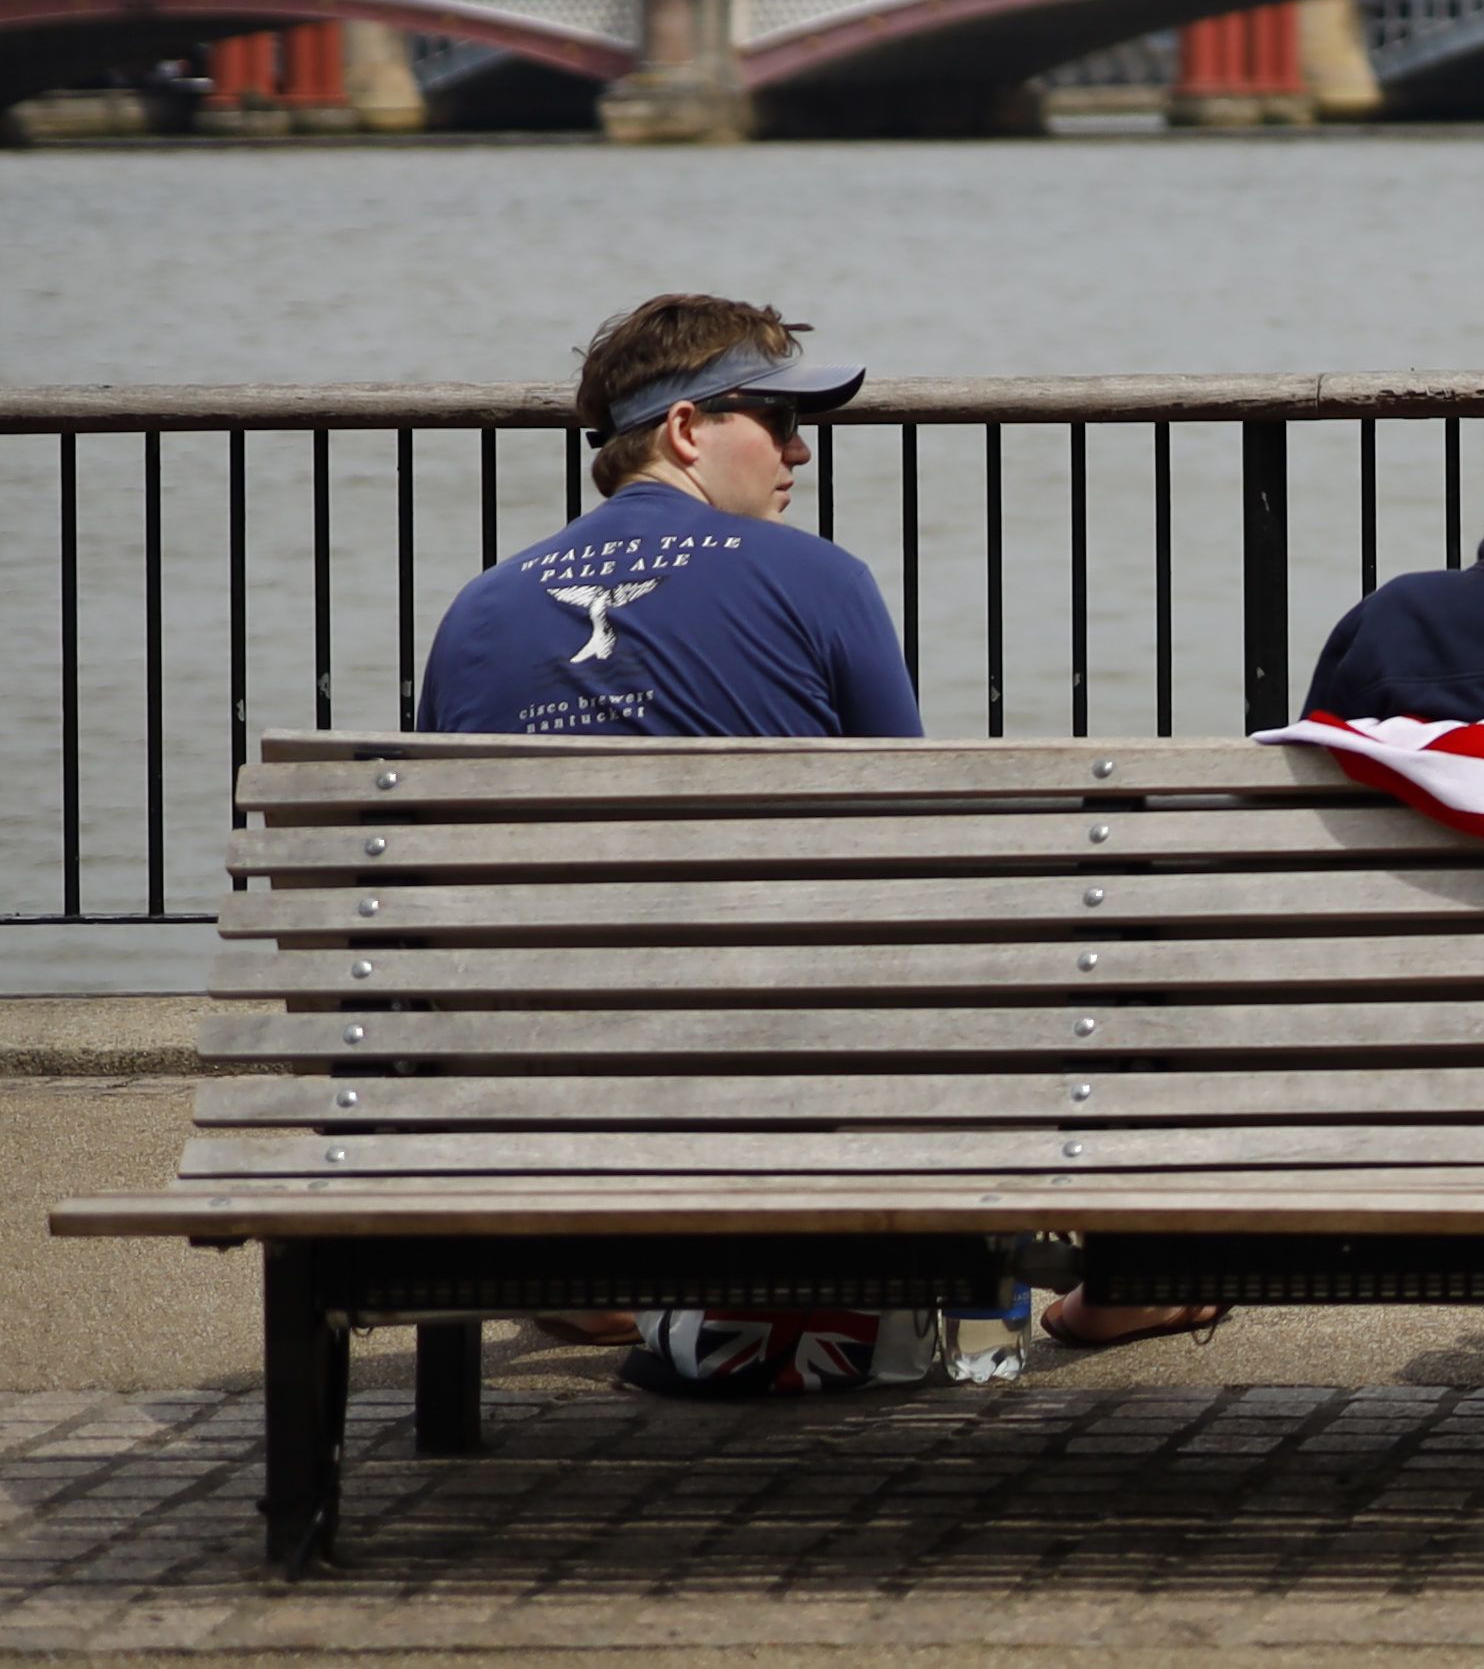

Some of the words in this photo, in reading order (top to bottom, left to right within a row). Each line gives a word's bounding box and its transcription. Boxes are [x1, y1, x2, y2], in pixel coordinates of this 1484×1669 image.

[521, 538, 642, 572] WHALE'S
[660, 535, 742, 549] TALE
[540, 560, 617, 582] PALE
[629, 553, 691, 572] ALE
[519, 701, 569, 720] cisco
[577, 689, 655, 710] brewers
[526, 706, 646, 734] nantucket
